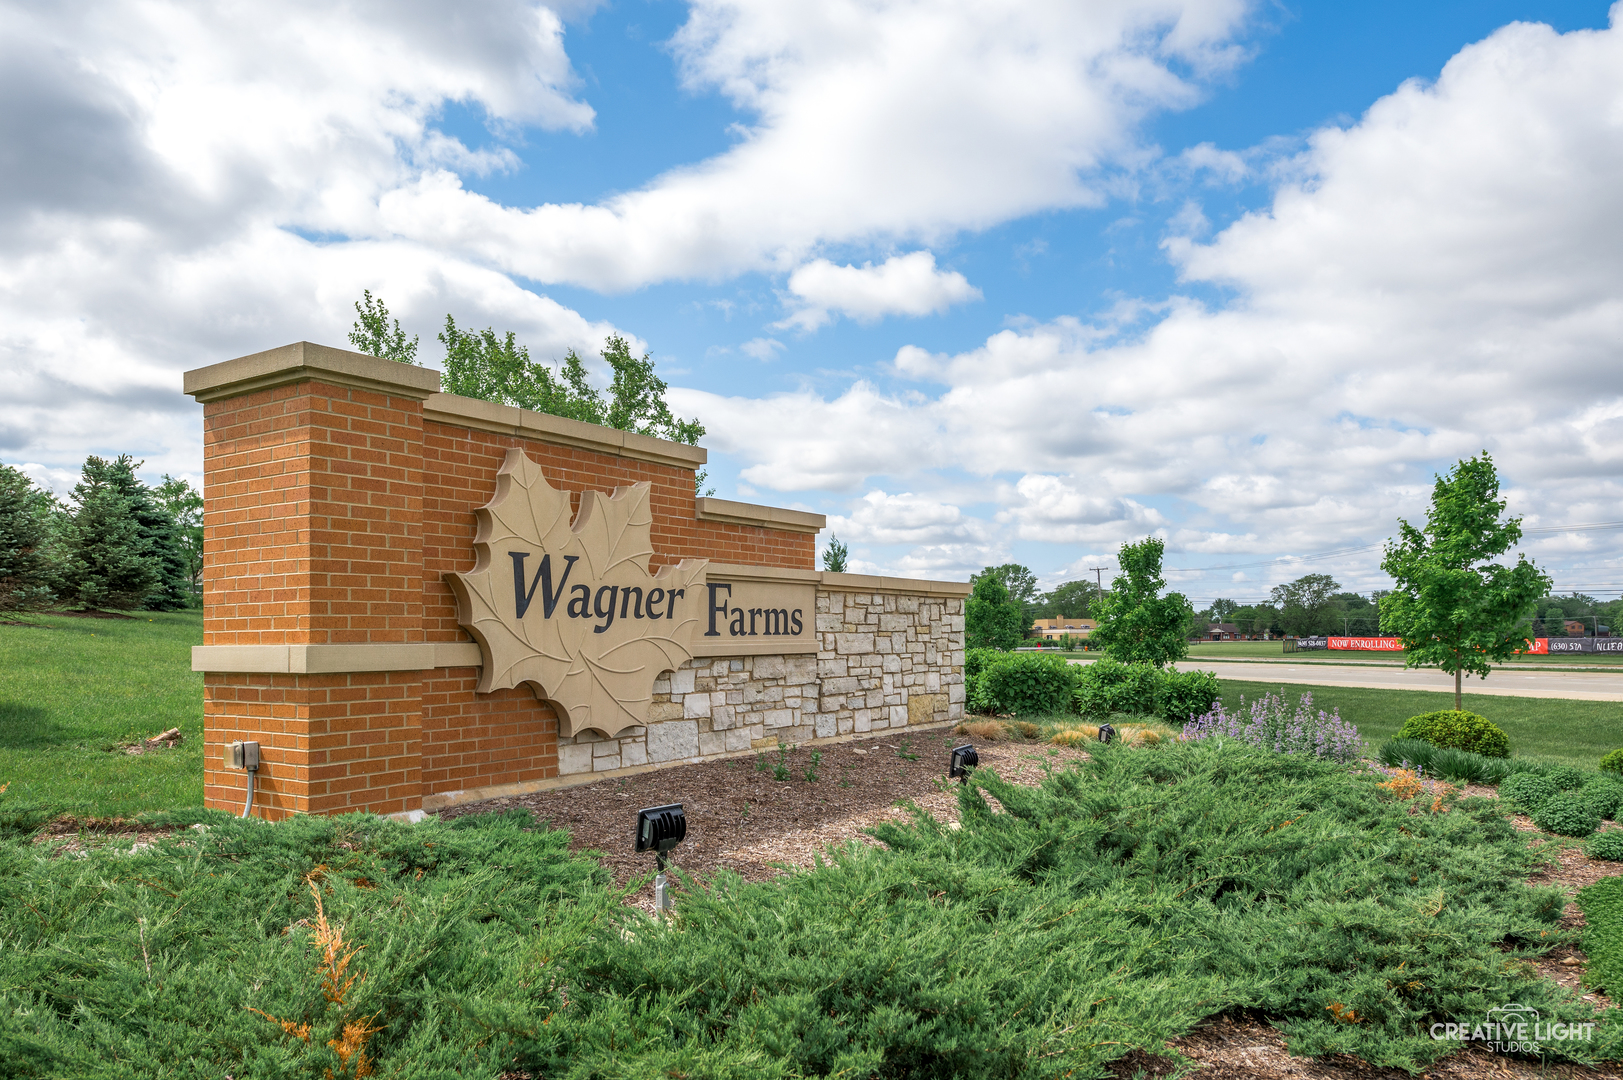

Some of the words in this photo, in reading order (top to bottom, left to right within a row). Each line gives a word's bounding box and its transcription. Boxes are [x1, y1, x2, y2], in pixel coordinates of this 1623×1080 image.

[507, 551, 685, 634] Wagner
[704, 582, 804, 637] Farms
[1331, 639, 1349, 648] NOW
[1350, 639, 1395, 649] ENROLLING
[1551, 642, 1568, 651] (630)
